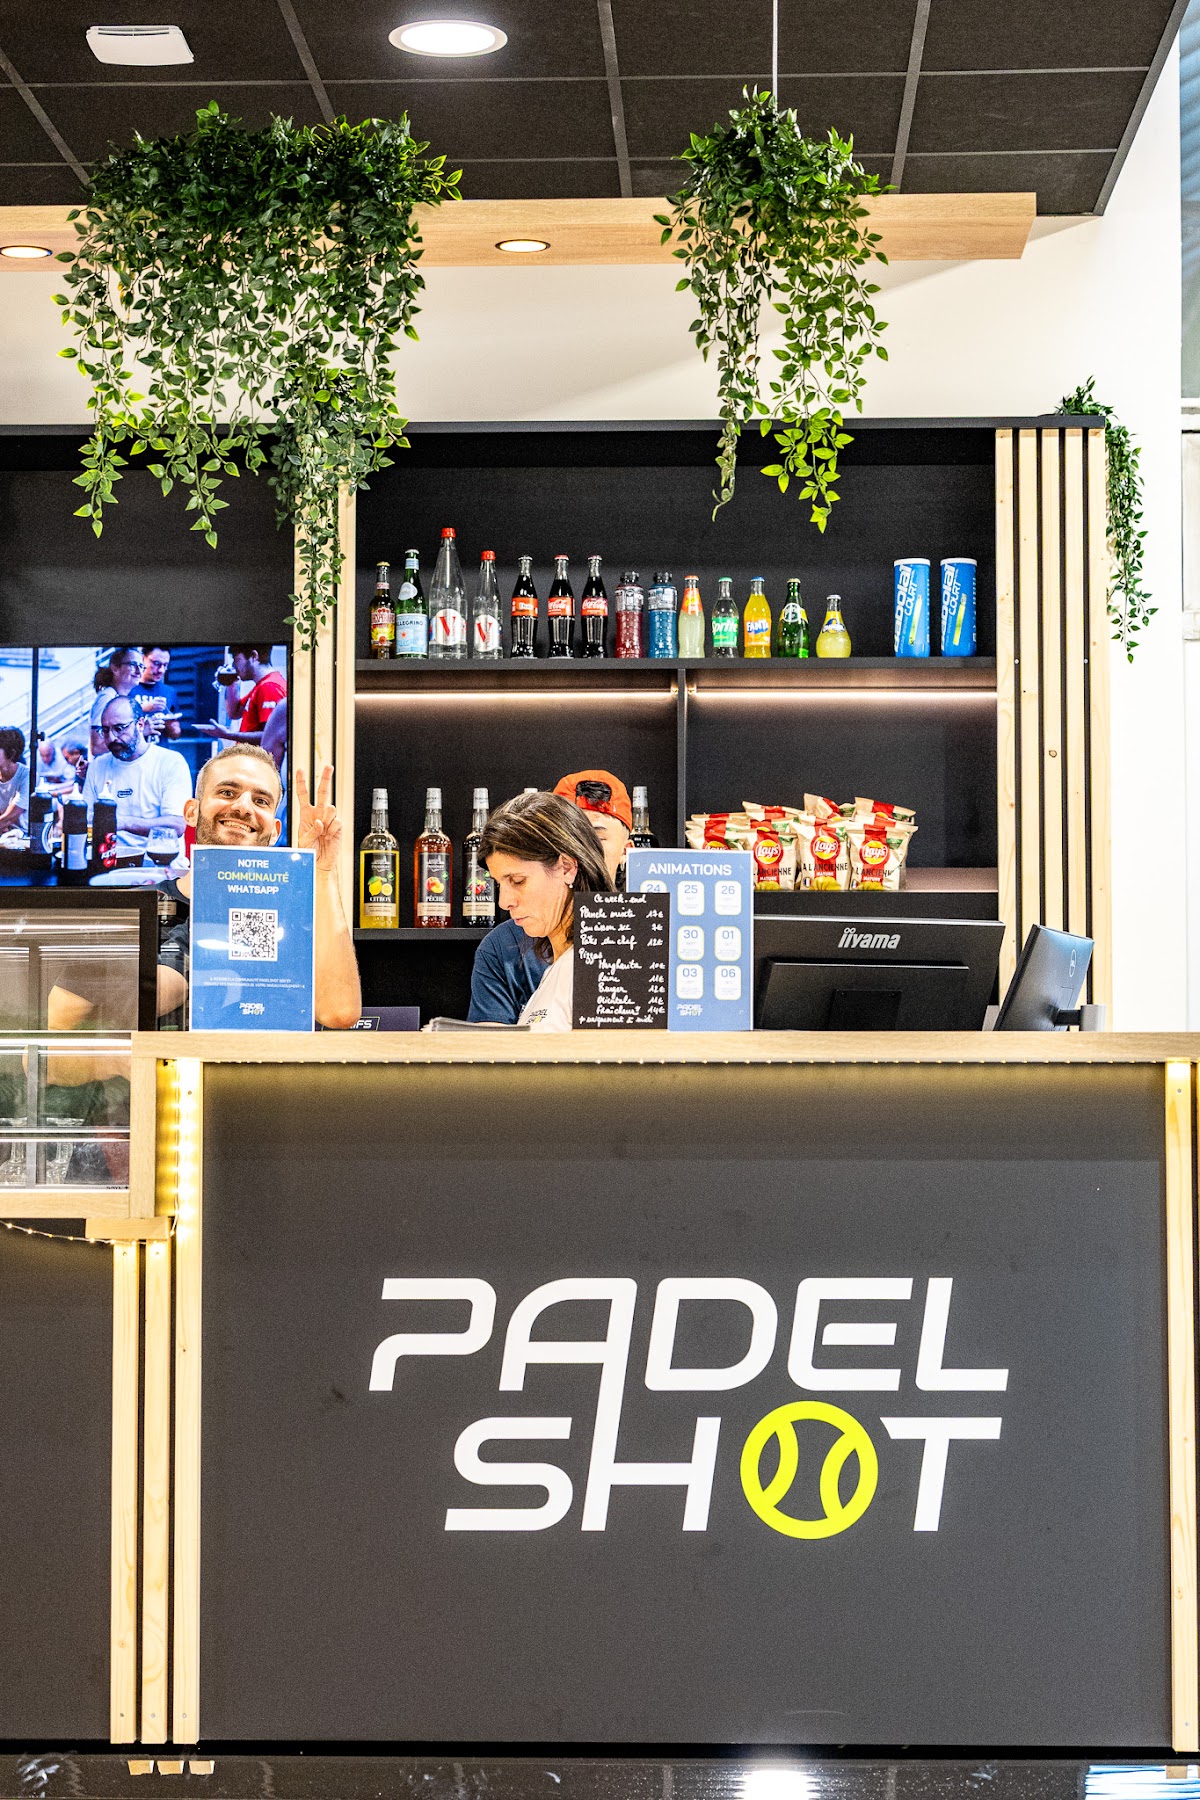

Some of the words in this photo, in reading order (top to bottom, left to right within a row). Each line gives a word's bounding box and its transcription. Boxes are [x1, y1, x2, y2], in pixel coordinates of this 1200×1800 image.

[904, 582, 918, 617] COURT
[948, 581, 962, 616] COURT
[237, 859, 269, 869] NOTRE
[647, 862, 733, 876] ANIMATIONS
[217, 871, 289, 883] COMMUNAUTÉ
[227, 884, 280, 895] WHATSAPP
[646, 883, 661, 893] 24
[684, 884, 698, 894] 25
[721, 885, 736, 895] 26
[579, 905, 608, 919] Planche
[609, 907, 636, 918] mixte
[579, 921, 616, 934] Saucisson
[617, 923, 632, 931] sec
[683, 929, 698, 939] 30
[722, 930, 735, 940] 01
[838, 927, 901, 950] iiyama
[600, 936, 616, 946] du
[617, 935, 638, 951] chef
[578, 947, 604, 965] Pizzas
[682, 968, 697, 978] 03
[721, 968, 736, 978] 06
[368, 1277, 1010, 1392] PADEL
[444, 1400, 1003, 1540] SHOT
